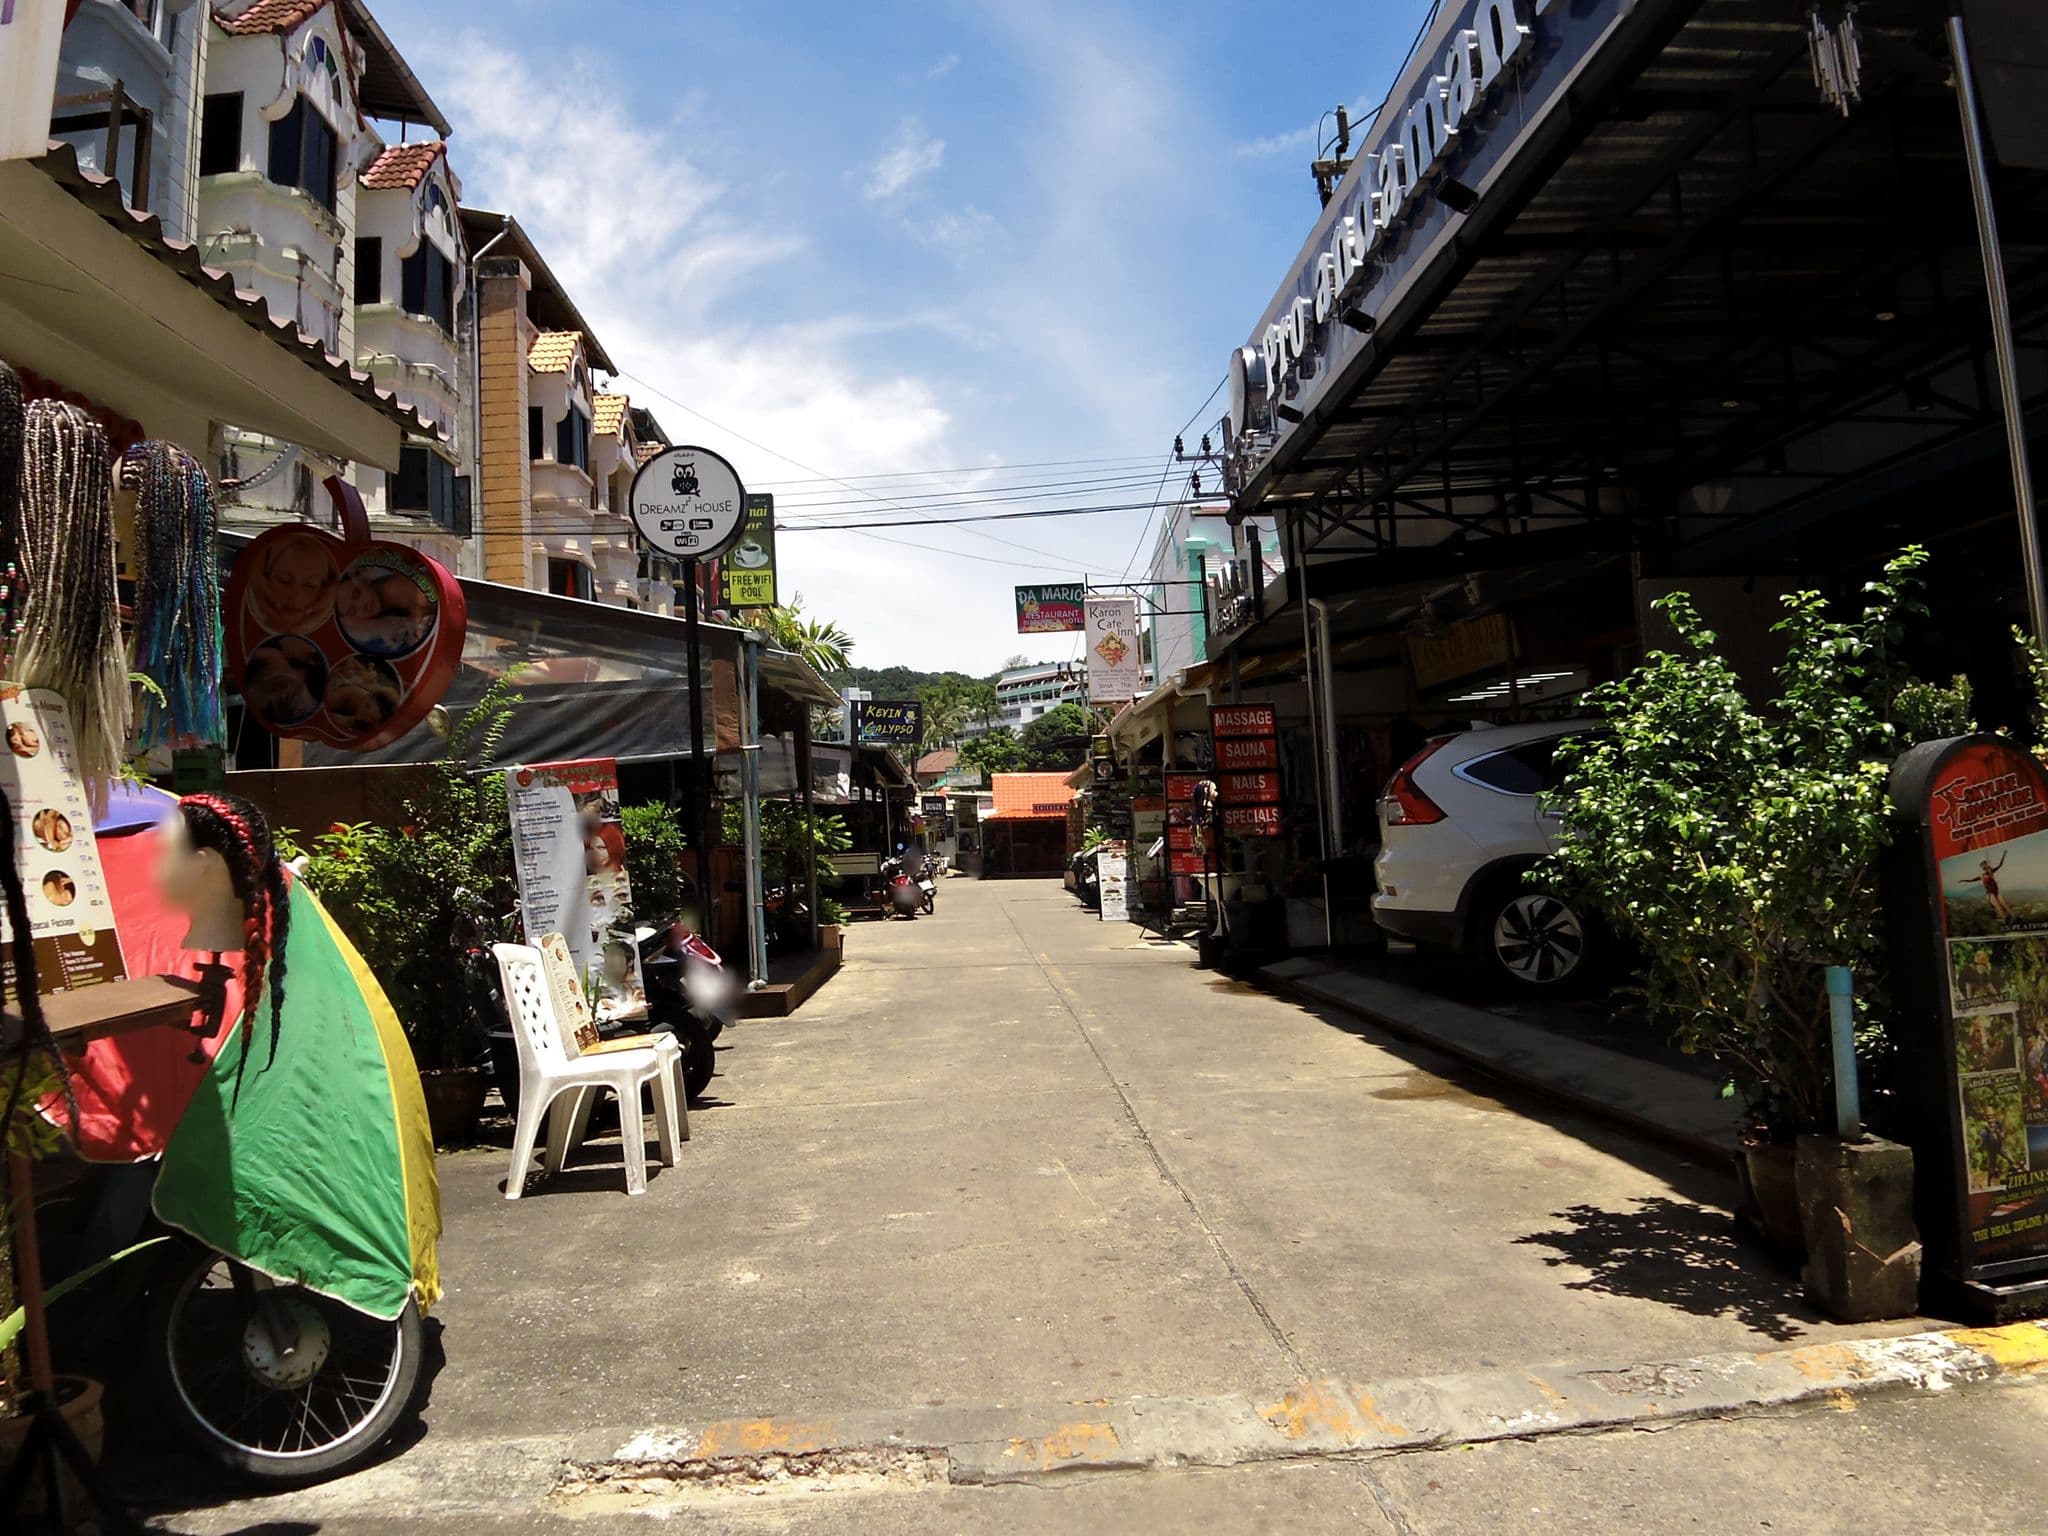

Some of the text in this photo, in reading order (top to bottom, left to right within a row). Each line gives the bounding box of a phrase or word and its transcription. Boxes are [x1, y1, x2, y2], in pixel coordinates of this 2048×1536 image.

[694, 500, 733, 513] HOUSE
[731, 574, 771, 586] FREE WIFI
[741, 587, 762, 598] POOL
[1017, 586, 1083, 603] DA MARIO
[1025, 609, 1079, 621] RESTAURANT
[1089, 606, 1121, 619] Karon
[1117, 627, 1133, 637] Inn
[1215, 711, 1272, 727] MASSAGE
[864, 721, 914, 735] CALYPSO
[1225, 742, 1267, 757] SAUNA
[1231, 774, 1266, 790] NAILS
[1958, 787, 2033, 825] ADVENTURE
[1224, 808, 1279, 825] SPECIALS
